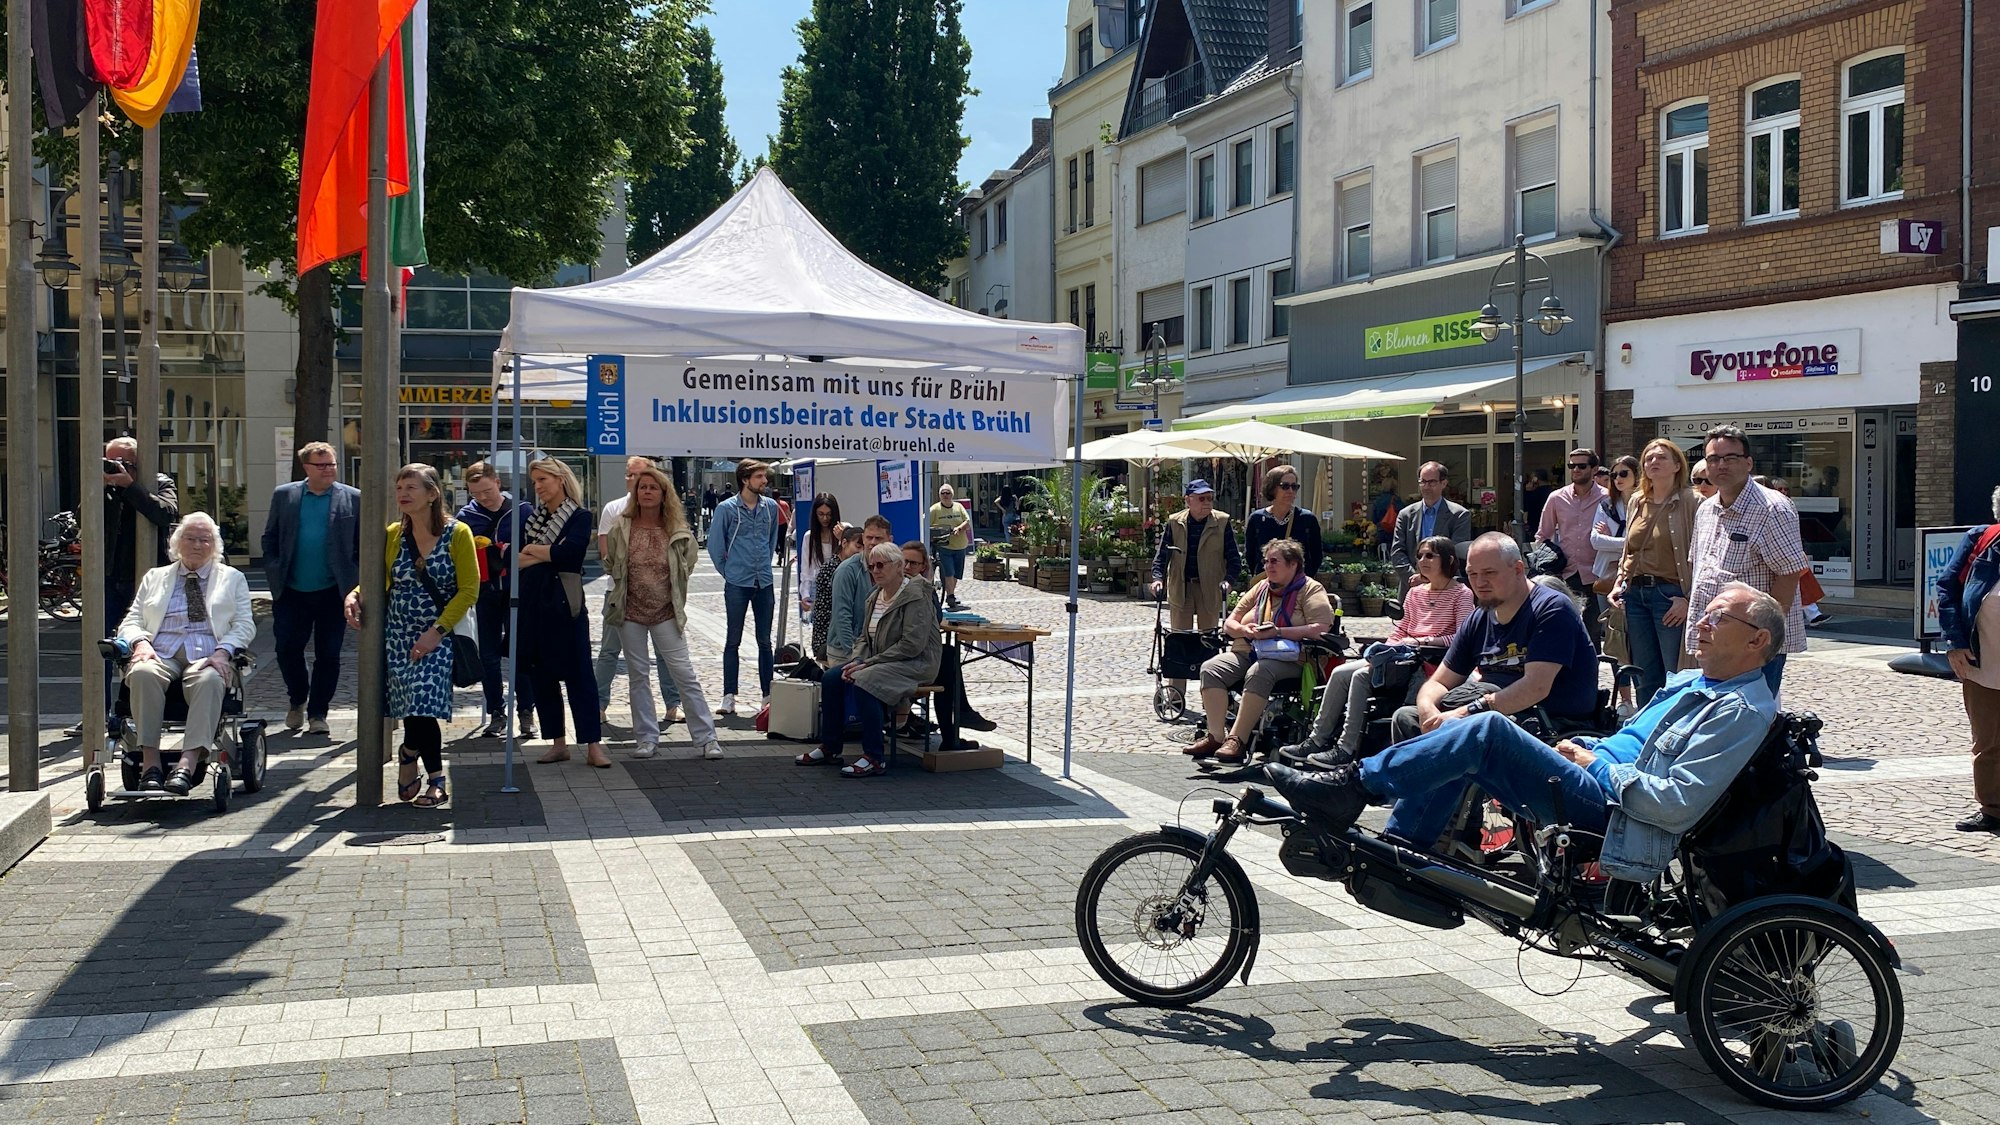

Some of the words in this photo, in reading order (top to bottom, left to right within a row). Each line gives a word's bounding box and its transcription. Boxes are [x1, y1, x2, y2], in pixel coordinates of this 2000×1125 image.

[1386, 328, 1430, 350] Blumen
[1703, 342, 1838, 380] yourfone
[683, 367, 815, 392] Gemeinsam
[823, 373, 860, 394] mit
[868, 379, 904, 397] uns
[911, 376, 943, 399] für
[950, 379, 1006, 402] Brühl
[1934, 382, 1947, 395] 12
[1970, 376, 1992, 393] 10
[598, 392, 620, 446] Brühl
[653, 398, 854, 427] Inklusionsbeirat
[860, 404, 899, 428] der
[905, 406, 966, 431] Stadt
[972, 410, 1031, 434] Brühl
[740, 432, 955, 453] inklusionsbeirat@bruehl.de
[1588, 931, 1628, 953] HASE
